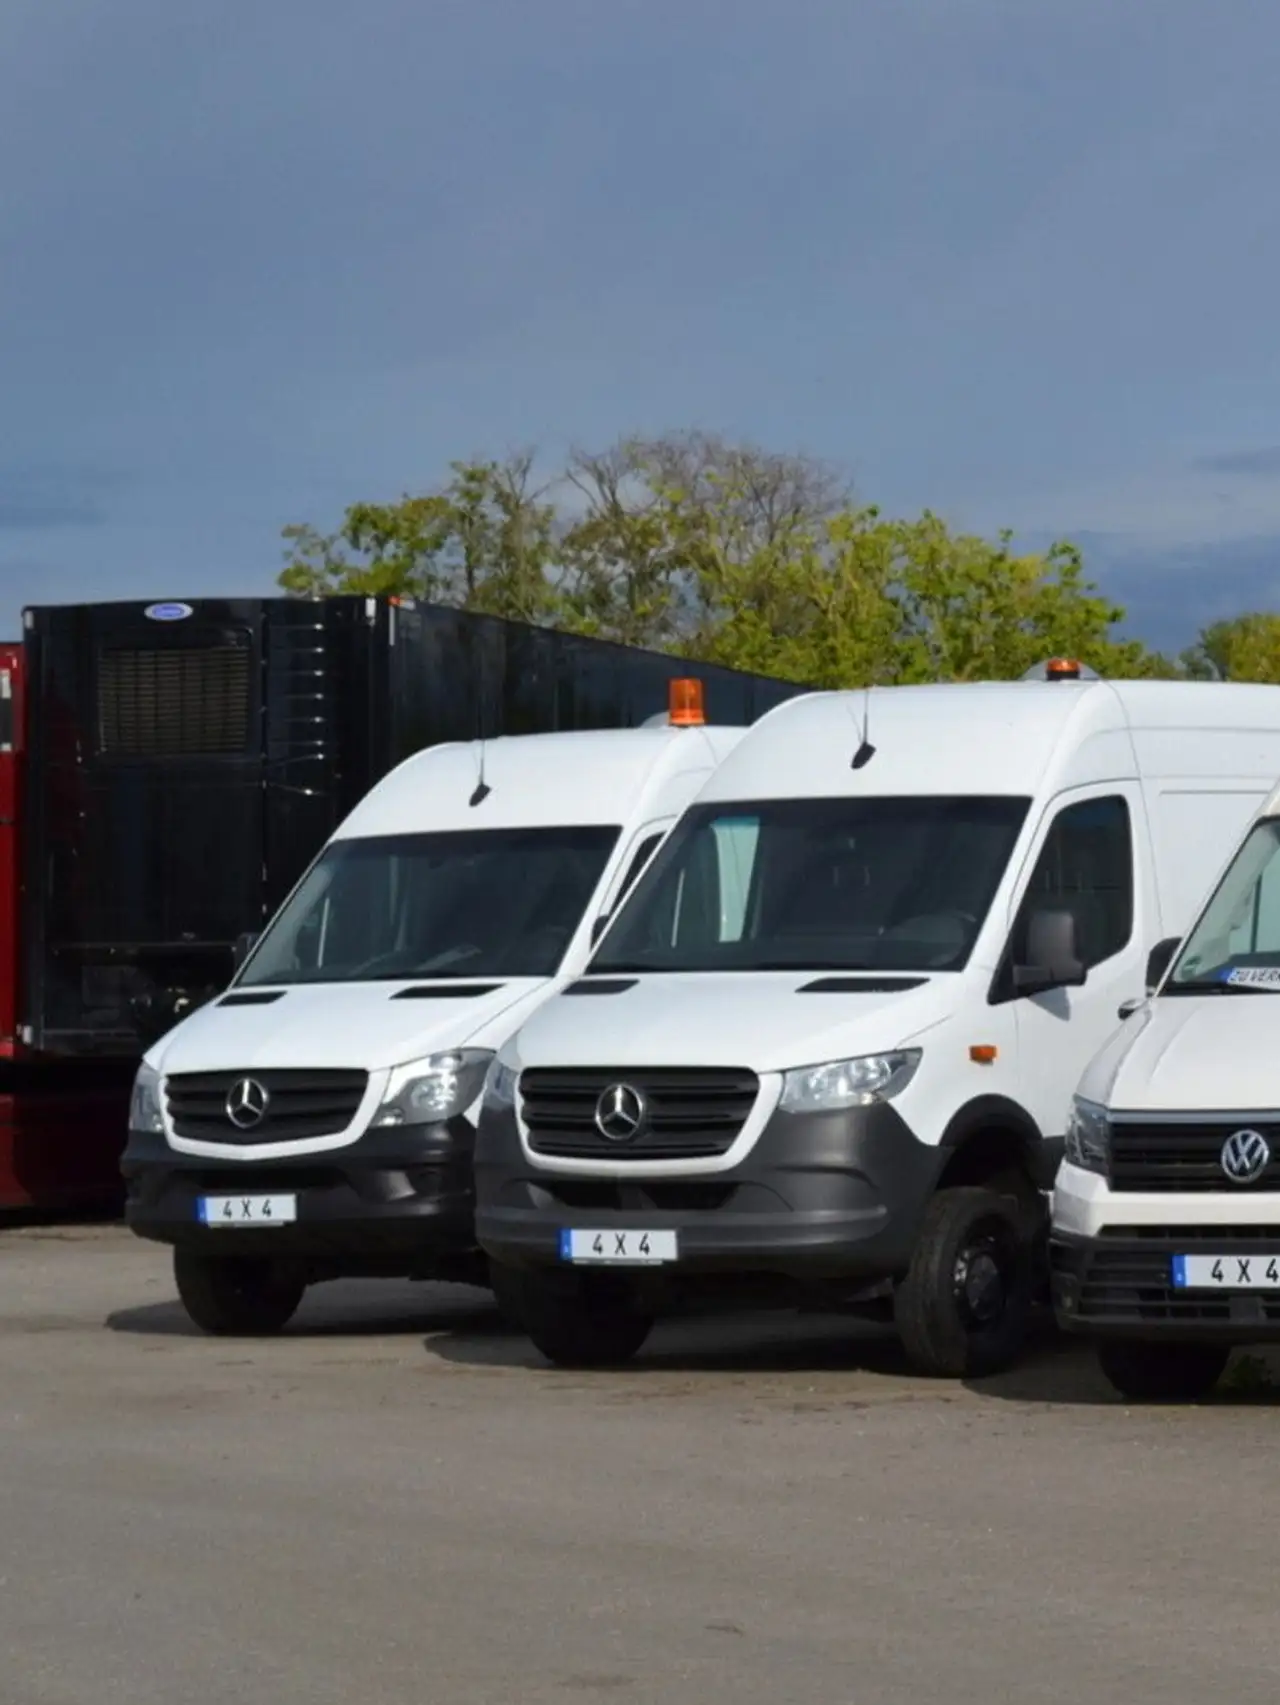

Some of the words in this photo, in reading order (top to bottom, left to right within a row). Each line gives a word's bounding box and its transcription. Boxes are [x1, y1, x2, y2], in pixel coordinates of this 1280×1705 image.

[223, 1199, 233, 1219] 4
[241, 1197, 252, 1218] X
[262, 1198, 272, 1218] 4
[592, 1232, 603, 1255] 4
[614, 1231, 627, 1255] X
[639, 1231, 651, 1255] 4
[1211, 1258, 1224, 1283] 4
[1237, 1258, 1251, 1283] X
[1265, 1257, 1279, 1283] 4
